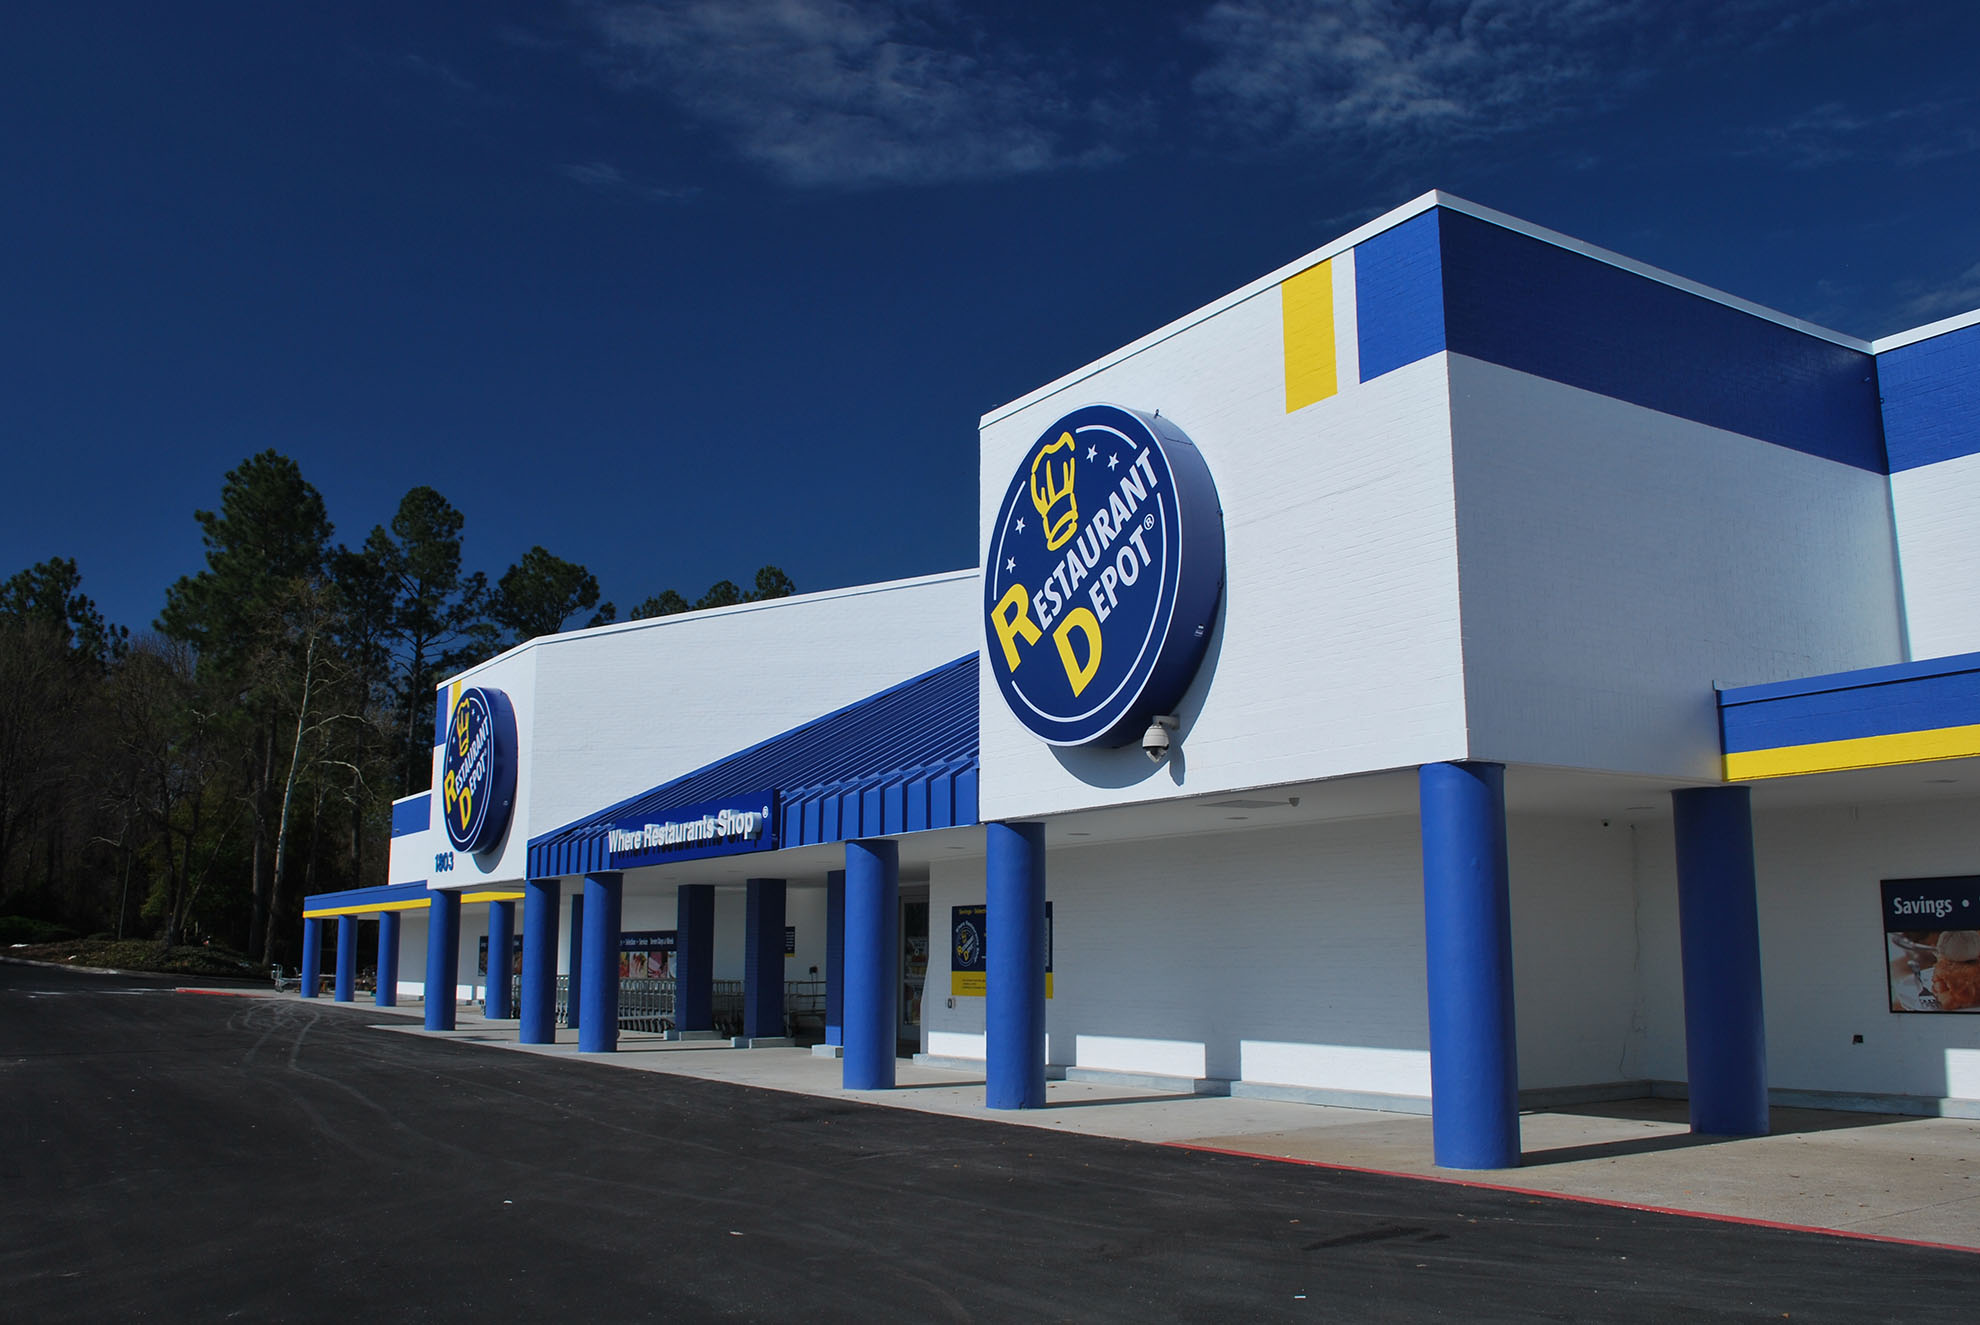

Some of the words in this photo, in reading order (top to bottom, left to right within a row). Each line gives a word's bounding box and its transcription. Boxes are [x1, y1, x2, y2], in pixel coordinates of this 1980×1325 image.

[991, 446, 1160, 673] RESTAURANT
[444, 716, 489, 814] RESTAURANT
[608, 829, 643, 853] Where
[644, 815, 717, 848] Restaurants
[1893, 895, 1953, 918] Savings
